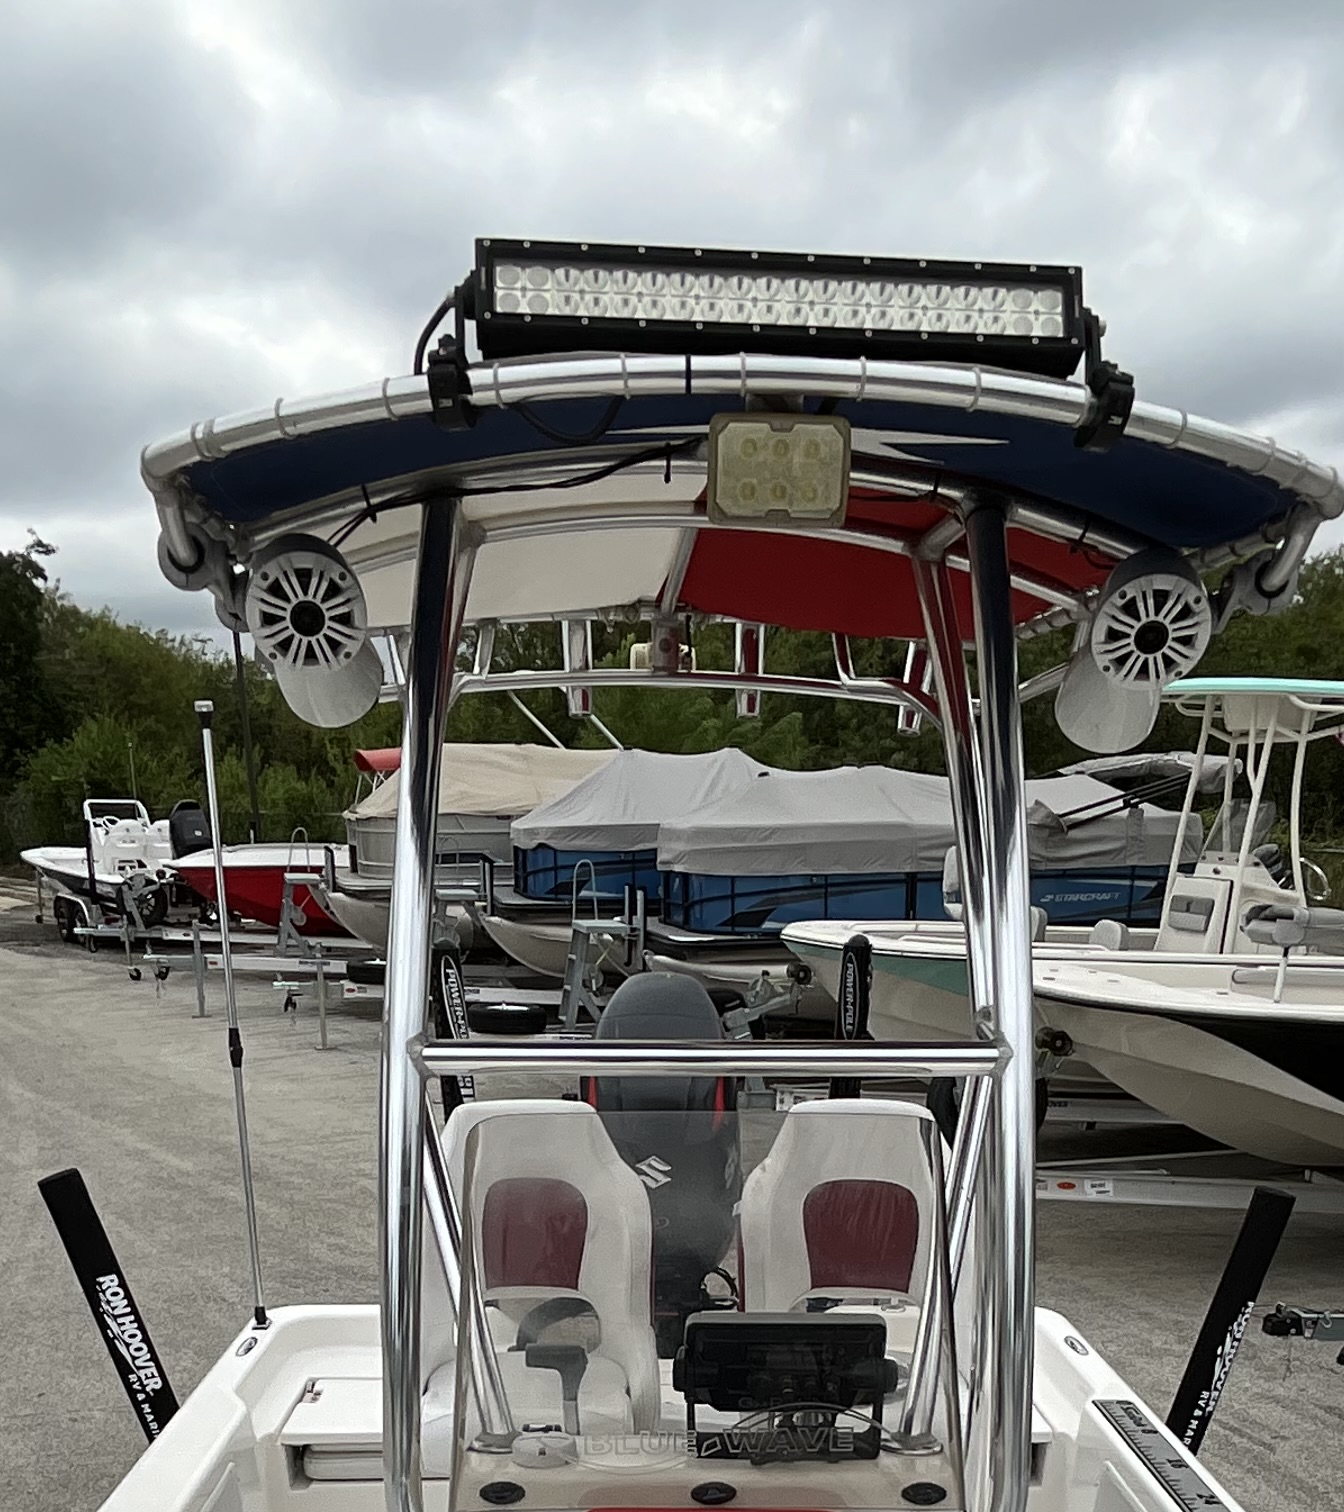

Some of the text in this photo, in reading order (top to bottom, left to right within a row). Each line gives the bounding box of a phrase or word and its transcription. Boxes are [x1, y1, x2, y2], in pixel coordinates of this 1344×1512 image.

[96, 1274, 163, 1396] RON HOOVER
[128, 1374, 142, 1391] RV
[1198, 1390, 1210, 1408] RV
[582, 1426, 854, 1456] BLUE WAVE
[1183, 1419, 1199, 1446] MAR
[1166, 1458, 1189, 1469] 16
[1196, 1493, 1222, 1505] 24
